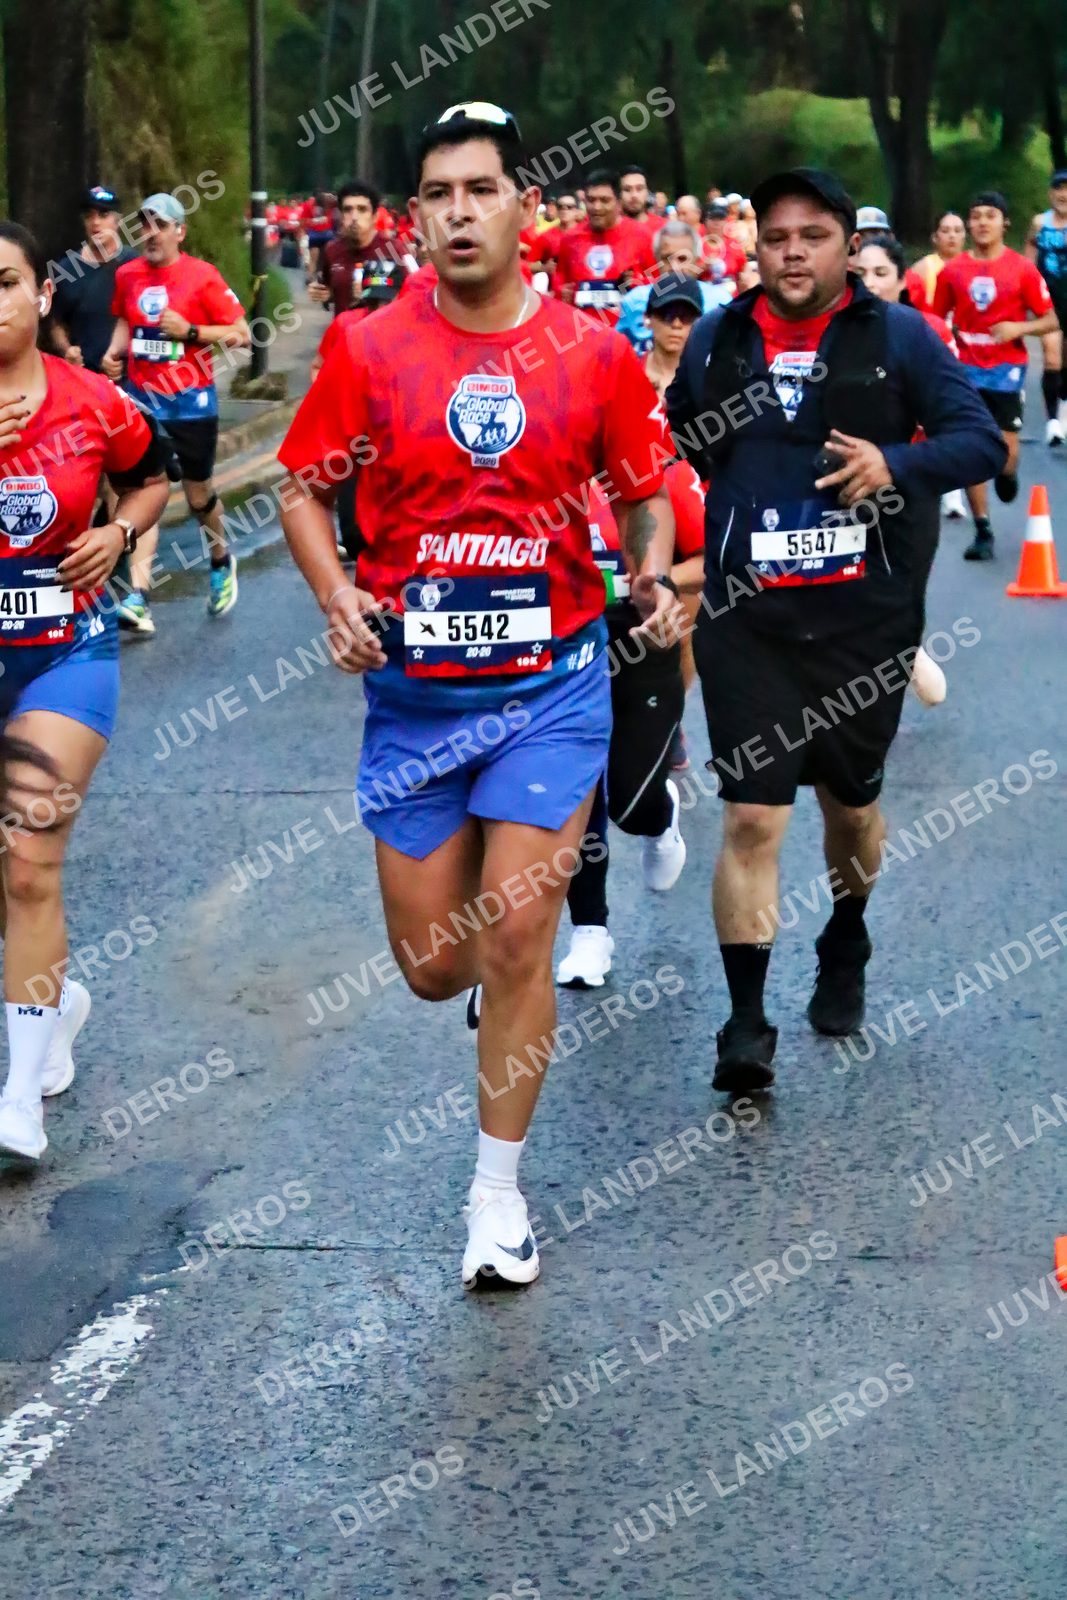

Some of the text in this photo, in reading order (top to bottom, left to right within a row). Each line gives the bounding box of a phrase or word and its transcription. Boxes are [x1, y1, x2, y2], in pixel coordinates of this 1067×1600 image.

[466, 382, 508, 394] BIMBO
[467, 396, 507, 413] Global
[458, 409, 491, 424] Race
[5, 481, 42, 491] BIMBO
[7, 493, 42, 507] Global
[416, 533, 549, 567] SANTIAGO
[786, 531, 836, 556] 5547
[0, 590, 38, 615] 401
[48, 629, 65, 639] 10K
[448, 613, 509, 641] 5542
